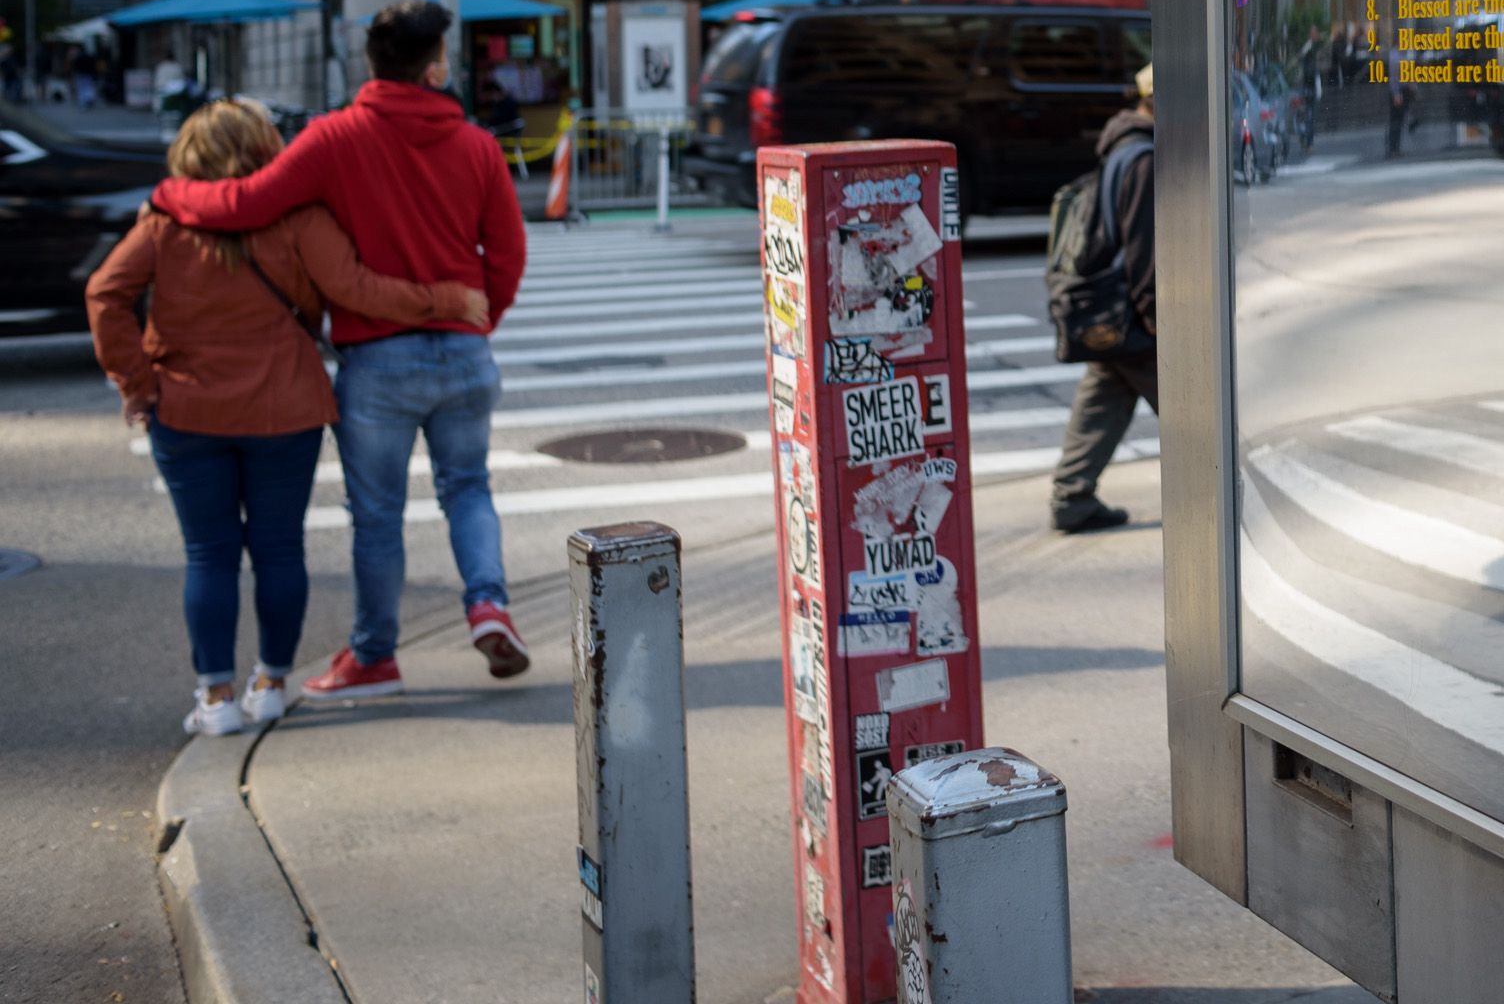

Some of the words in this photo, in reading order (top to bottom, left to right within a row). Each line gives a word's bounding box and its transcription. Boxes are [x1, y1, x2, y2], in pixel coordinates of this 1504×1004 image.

[1455, 0, 1479, 16] are
[1367, 28, 1380, 52] 9.
[1399, 27, 1450, 51] Blessed
[1455, 30, 1482, 49] are
[1369, 60, 1388, 83] 10.
[1400, 60, 1452, 83] Blessed
[1457, 64, 1482, 82] are
[846, 383, 917, 427] SMEER
[850, 418, 921, 462] SHARK
[923, 460, 955, 477] UWS
[866, 536, 934, 575] YUMAD
